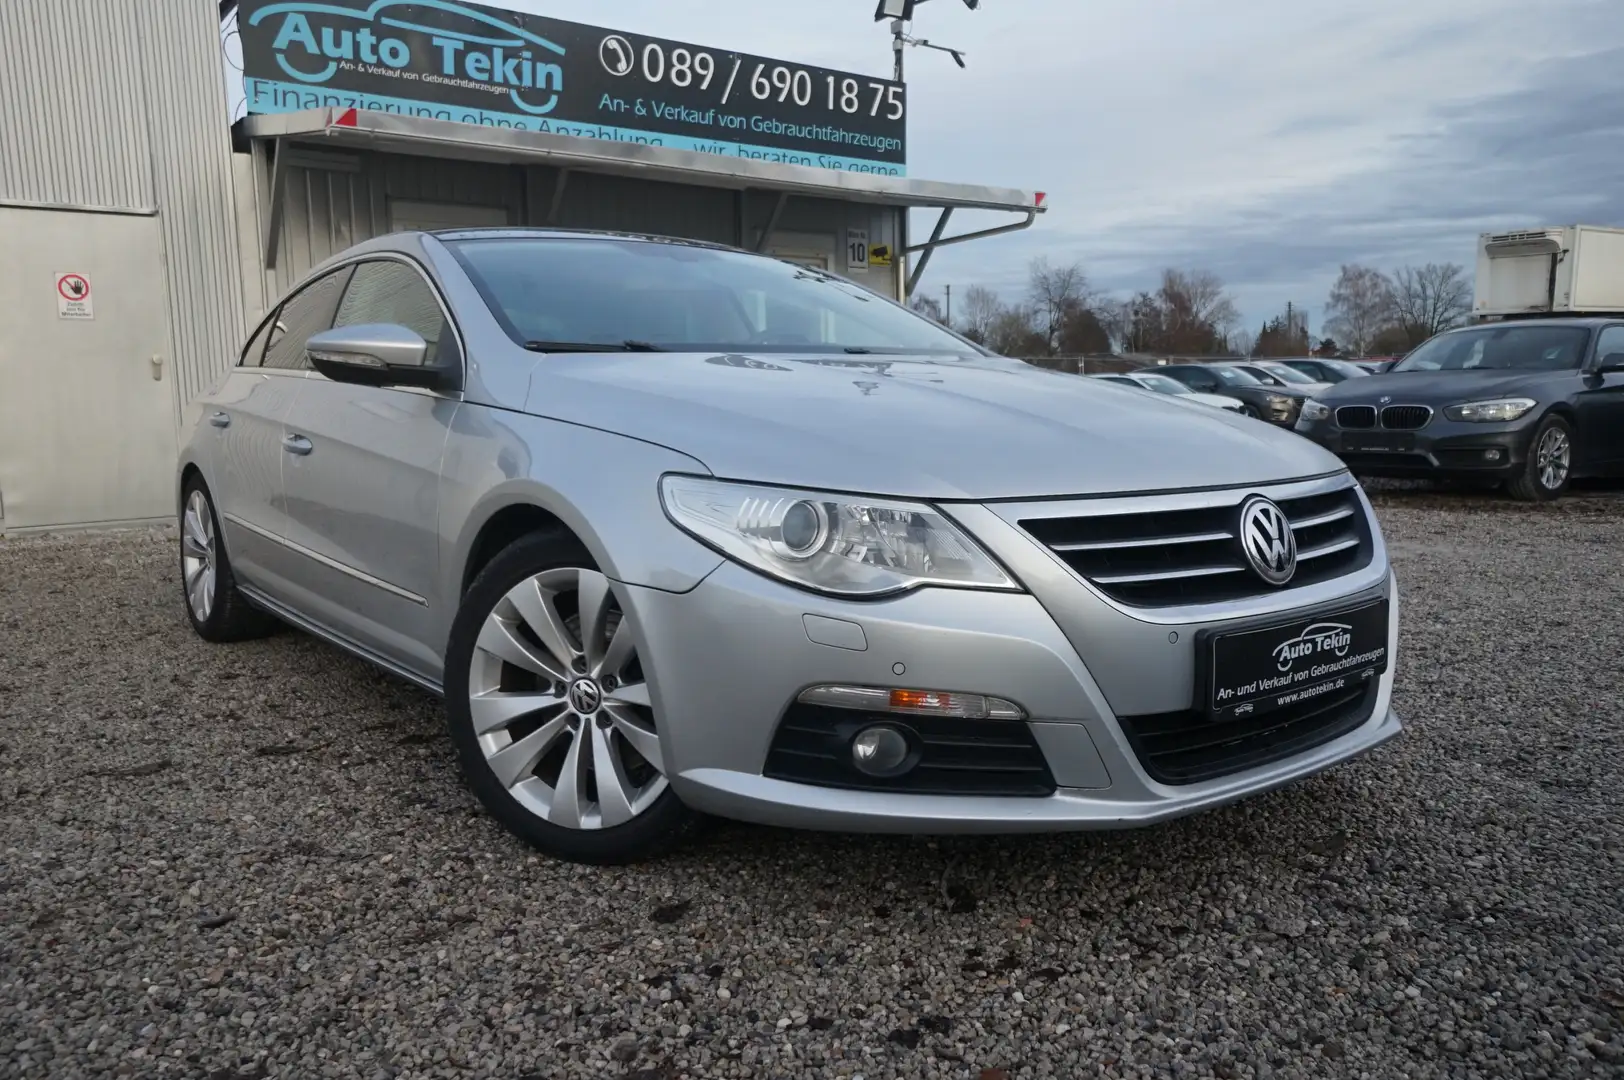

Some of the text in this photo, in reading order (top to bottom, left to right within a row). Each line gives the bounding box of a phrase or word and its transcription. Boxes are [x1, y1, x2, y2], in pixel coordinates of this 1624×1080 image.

[272, 12, 563, 92] Auto Tekin
[339, 60, 509, 95] An- & Verkauf von Gebrauchtfahrzeugen
[642, 43, 715, 90] 089
[751, 63, 812, 106] 690
[826, 75, 859, 114] 18
[869, 82, 903, 120] 75
[598, 93, 902, 152] An- & Verkauf von Gebrauchtfahrzeugen
[850, 243, 865, 262] 10
[1279, 632, 1350, 662] Auto Tekin
[1217, 688, 1235, 700] An-
[1237, 681, 1257, 696] und
[1259, 672, 1293, 691] Verkauf
[1293, 670, 1309, 682] von
[1311, 647, 1384, 677] Gebrauchtfahrzeugen
[1277, 679, 1344, 706] www.autotekin.de
